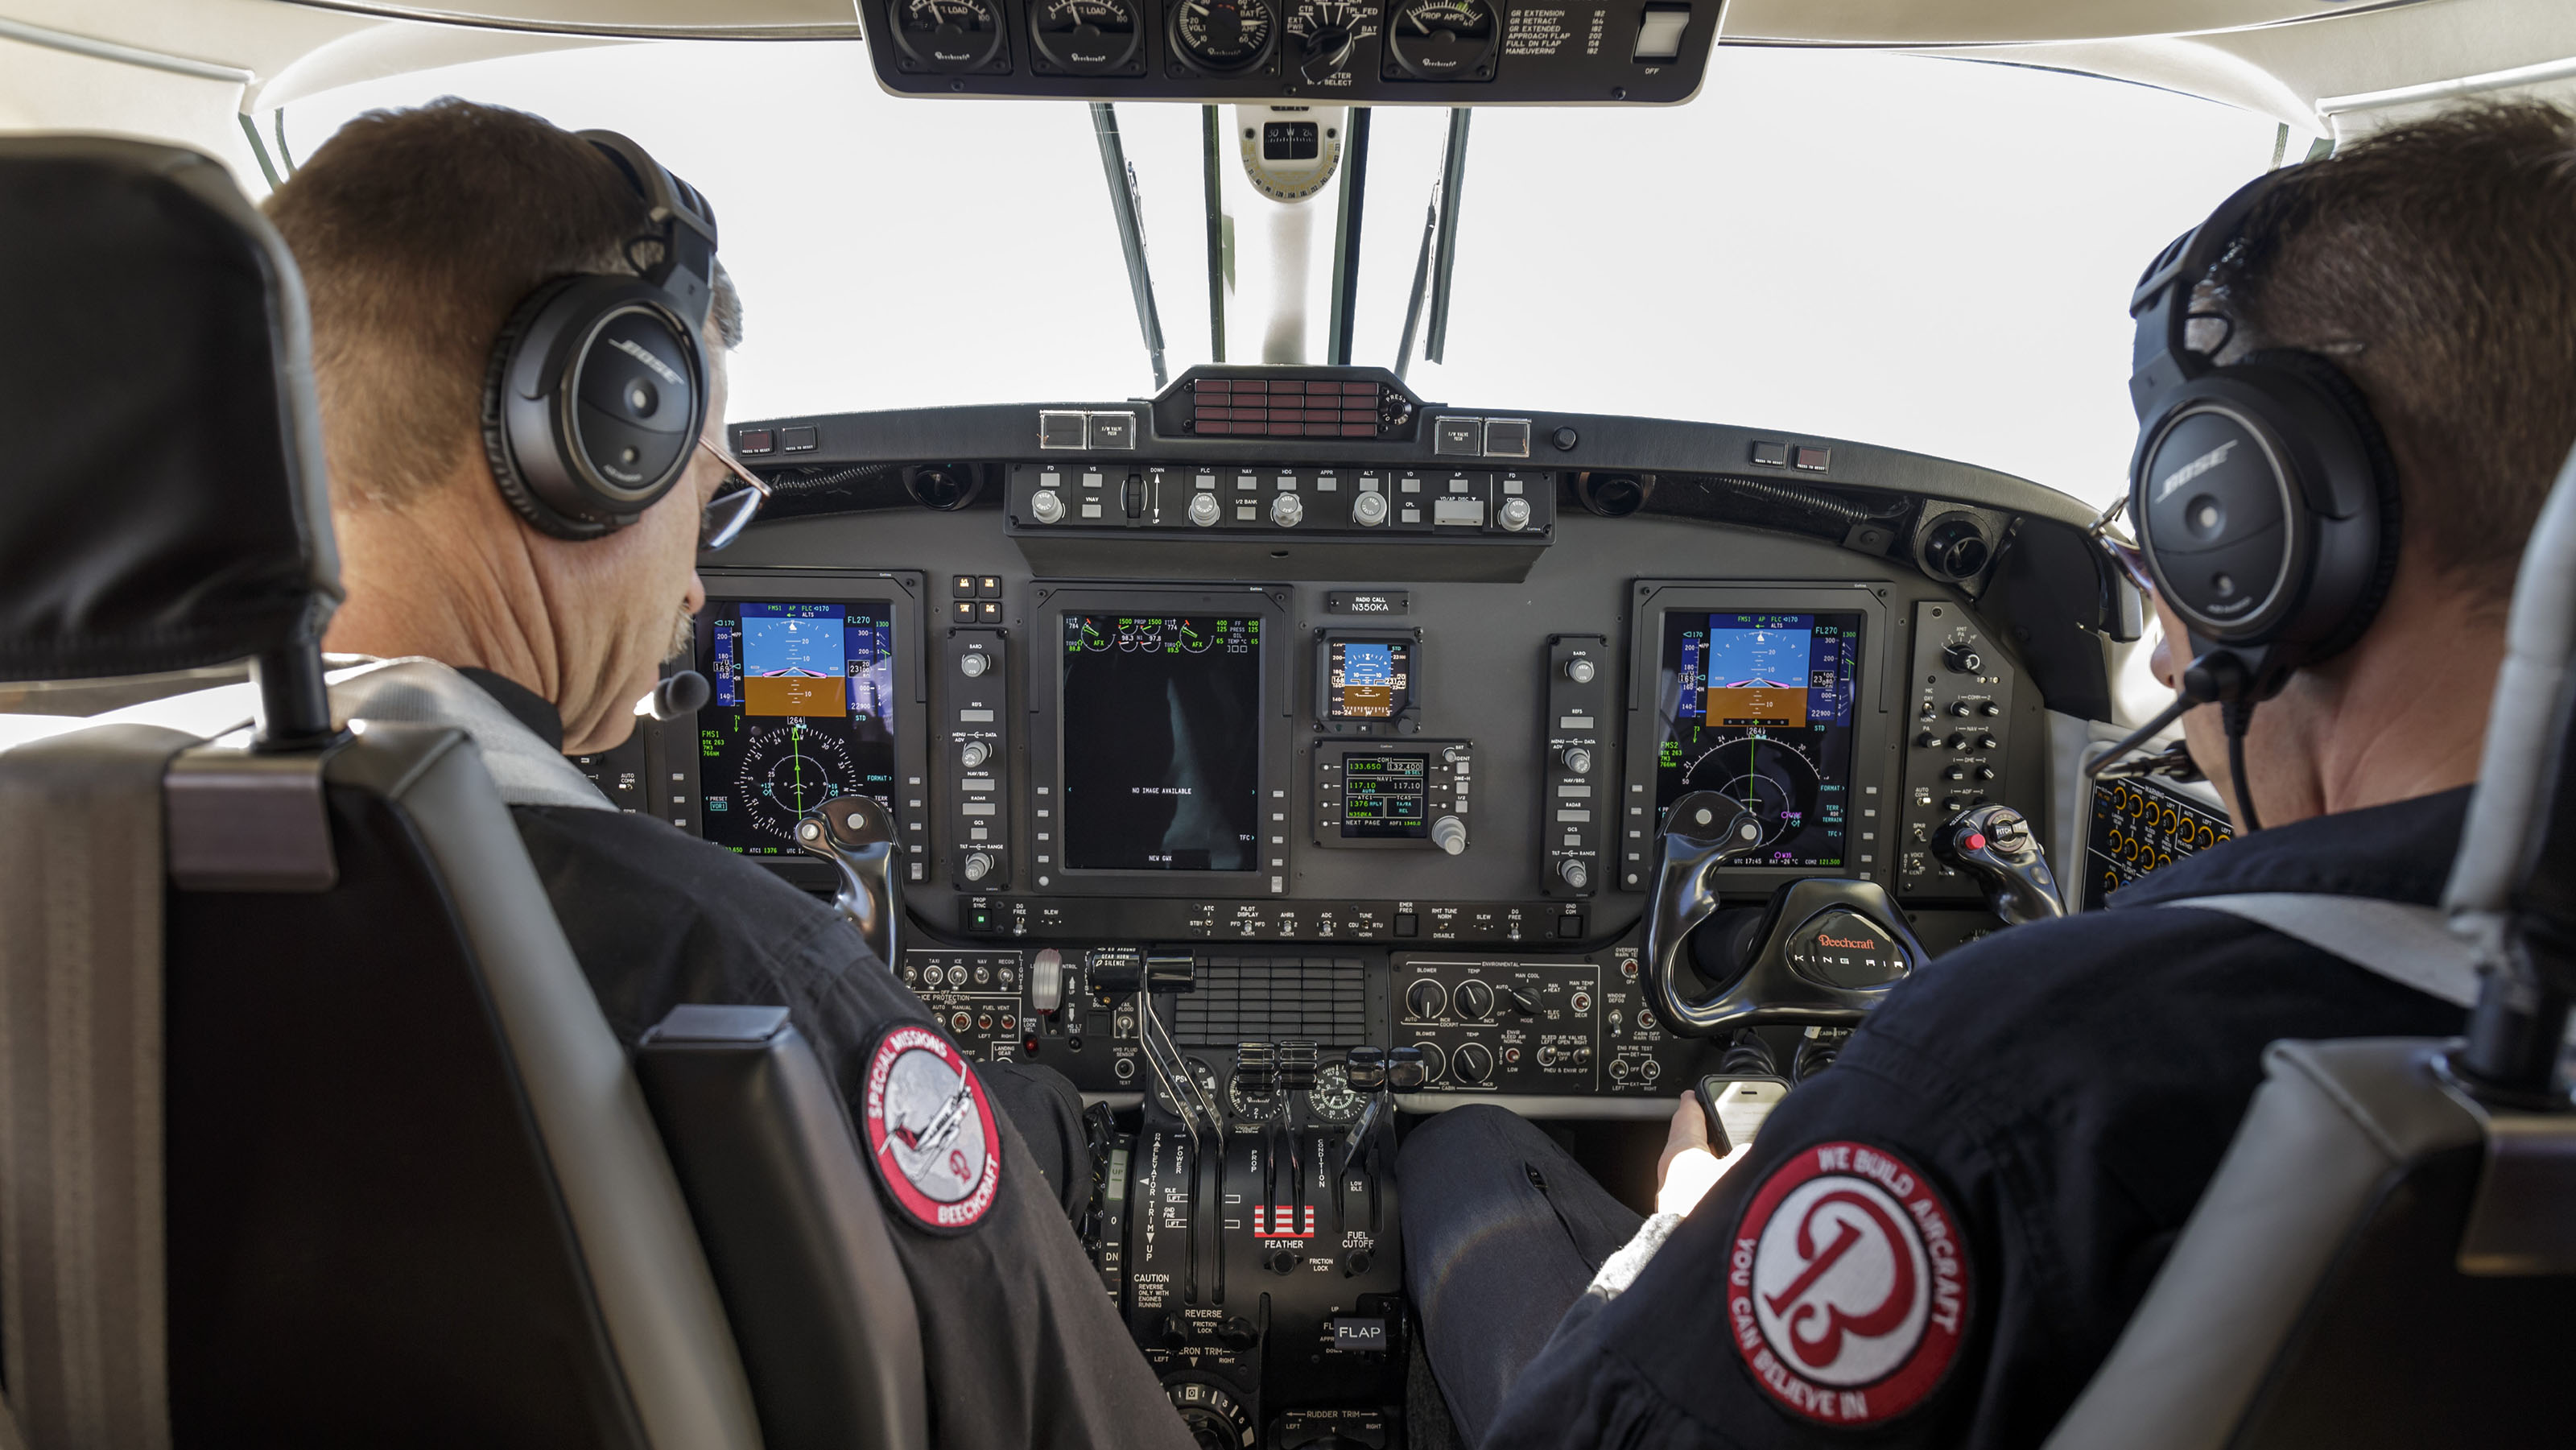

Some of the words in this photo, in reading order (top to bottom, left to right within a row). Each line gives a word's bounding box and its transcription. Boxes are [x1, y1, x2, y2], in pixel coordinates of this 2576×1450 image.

[1421, 12, 1441, 20] PROP
[1443, 12, 1464, 21] AMPS
[608, 337, 684, 385] BOSE
[1385, 394, 1406, 403] PRESS
[1382, 413, 1390, 421] TO
[1394, 414, 1409, 425] TEST
[2154, 439, 2239, 504] BOSE
[847, 616, 870, 624] FL270
[1815, 626, 1838, 634] FL270
[702, 730, 720, 738] FMS1
[2144, 785, 2165, 799] WARNING
[1996, 827, 2012, 836] PITCH
[1745, 857, 1762, 865] 17:45
[1818, 934, 1875, 950] Beechcraft
[1794, 954, 1850, 965] KING
[1865, 959, 1904, 969] AIR
[868, 1046, 896, 1119] SPECIAL
[890, 1029, 948, 1058] MISSIONS
[937, 1153, 998, 1224] BEECHCRAFT
[1347, 1231, 1368, 1240] FUEL
[1817, 1146, 1851, 1172] WE
[1852, 1147, 1915, 1198] BUILD
[1909, 1198, 1962, 1336] AIRCRAFT
[1265, 1240, 1304, 1249] FEATHER
[1342, 1240, 1374, 1248] CUTOFF
[1106, 1253, 1119, 1261] DN
[1730, 1237, 1757, 1287] YOU
[1133, 1274, 1170, 1283] CAUTION
[1732, 1296, 1761, 1350] CAN
[1340, 1327, 1381, 1338] FLAP
[1752, 1349, 1836, 1416] BELIEVE
[1839, 1390, 1869, 1420] IN
